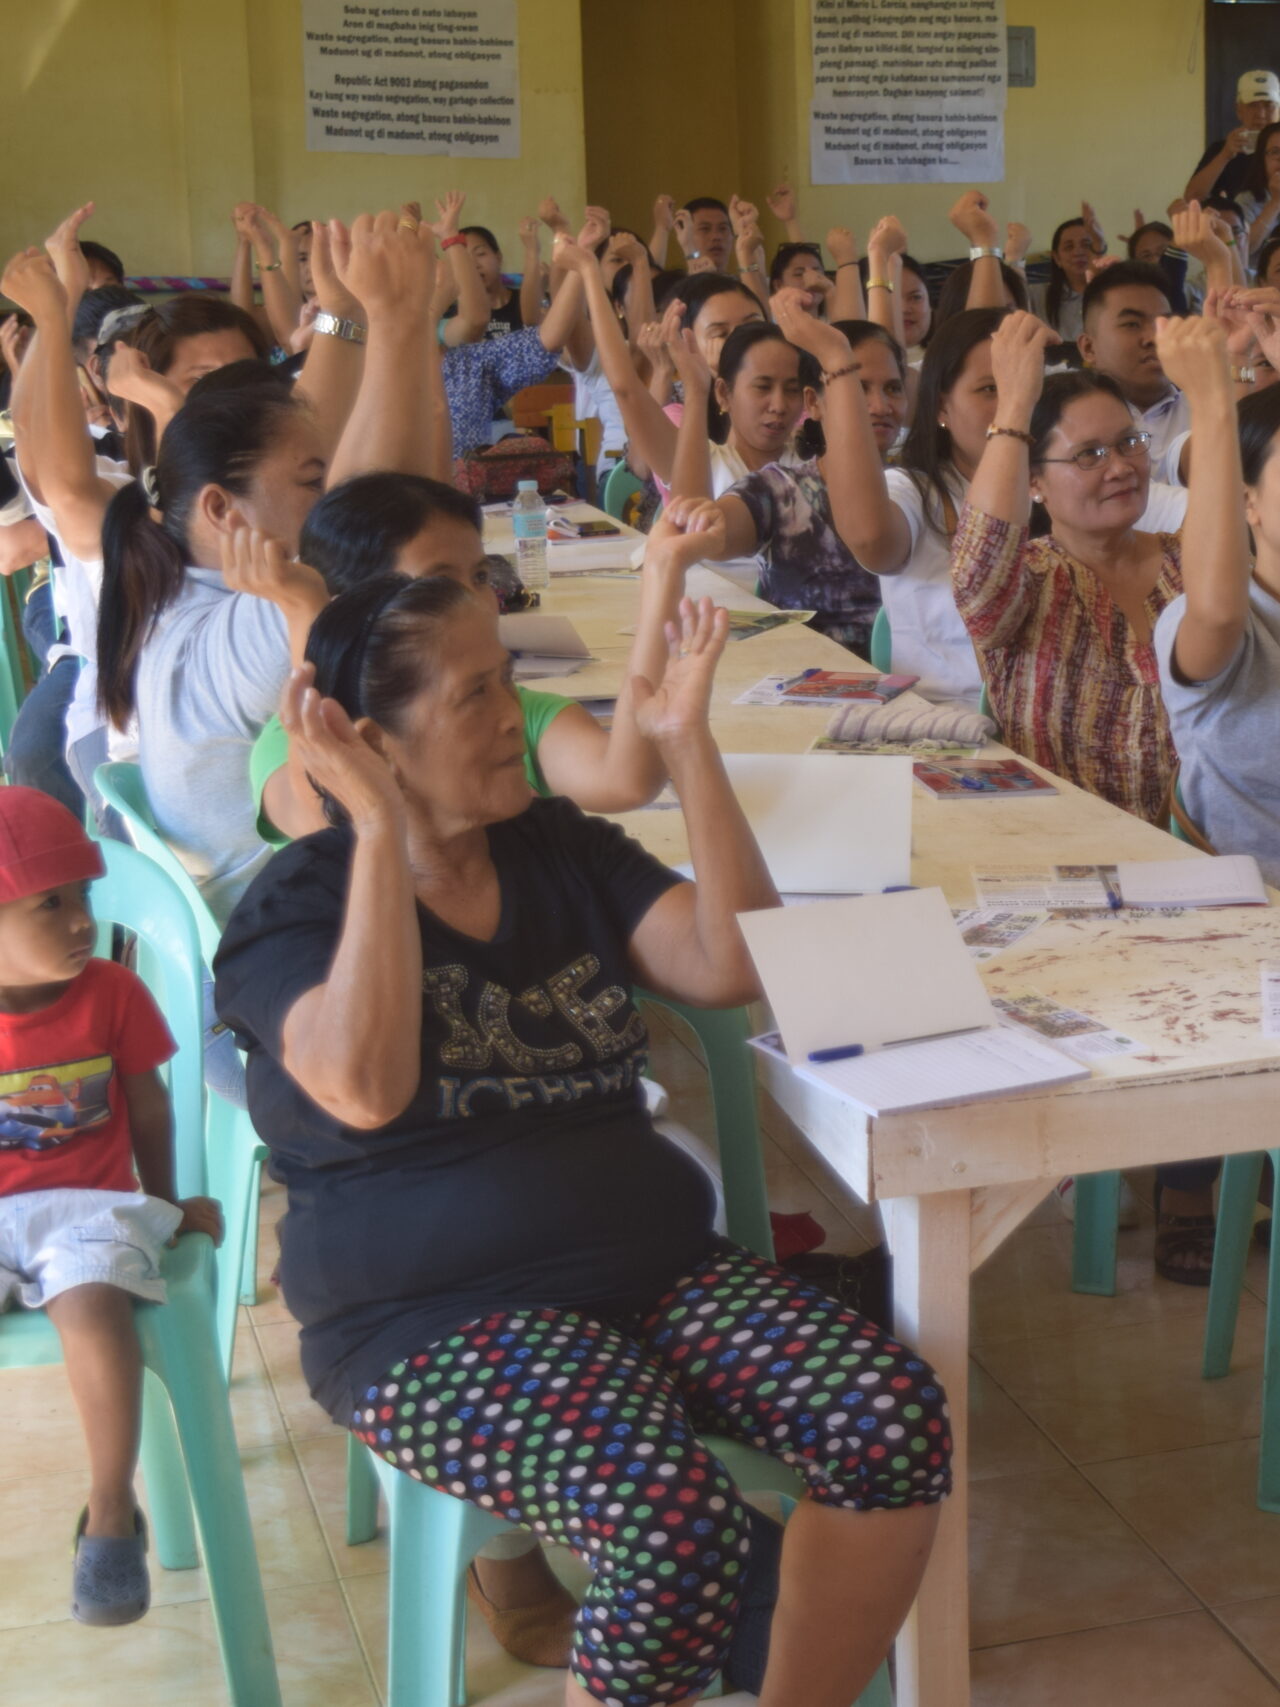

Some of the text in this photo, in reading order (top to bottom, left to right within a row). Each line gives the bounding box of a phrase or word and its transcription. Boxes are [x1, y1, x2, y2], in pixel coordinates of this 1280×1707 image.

[307, 32, 333, 41] Waste
[335, 74, 371, 87] Republic
[390, 77, 410, 87] 9003
[362, 94, 383, 102] waste
[449, 96, 477, 106] garbage
[479, 96, 514, 105] collection
[312, 107, 338, 118] Waste
[813, 111, 837, 120] Waste
[423, 953, 648, 1074] ICE
